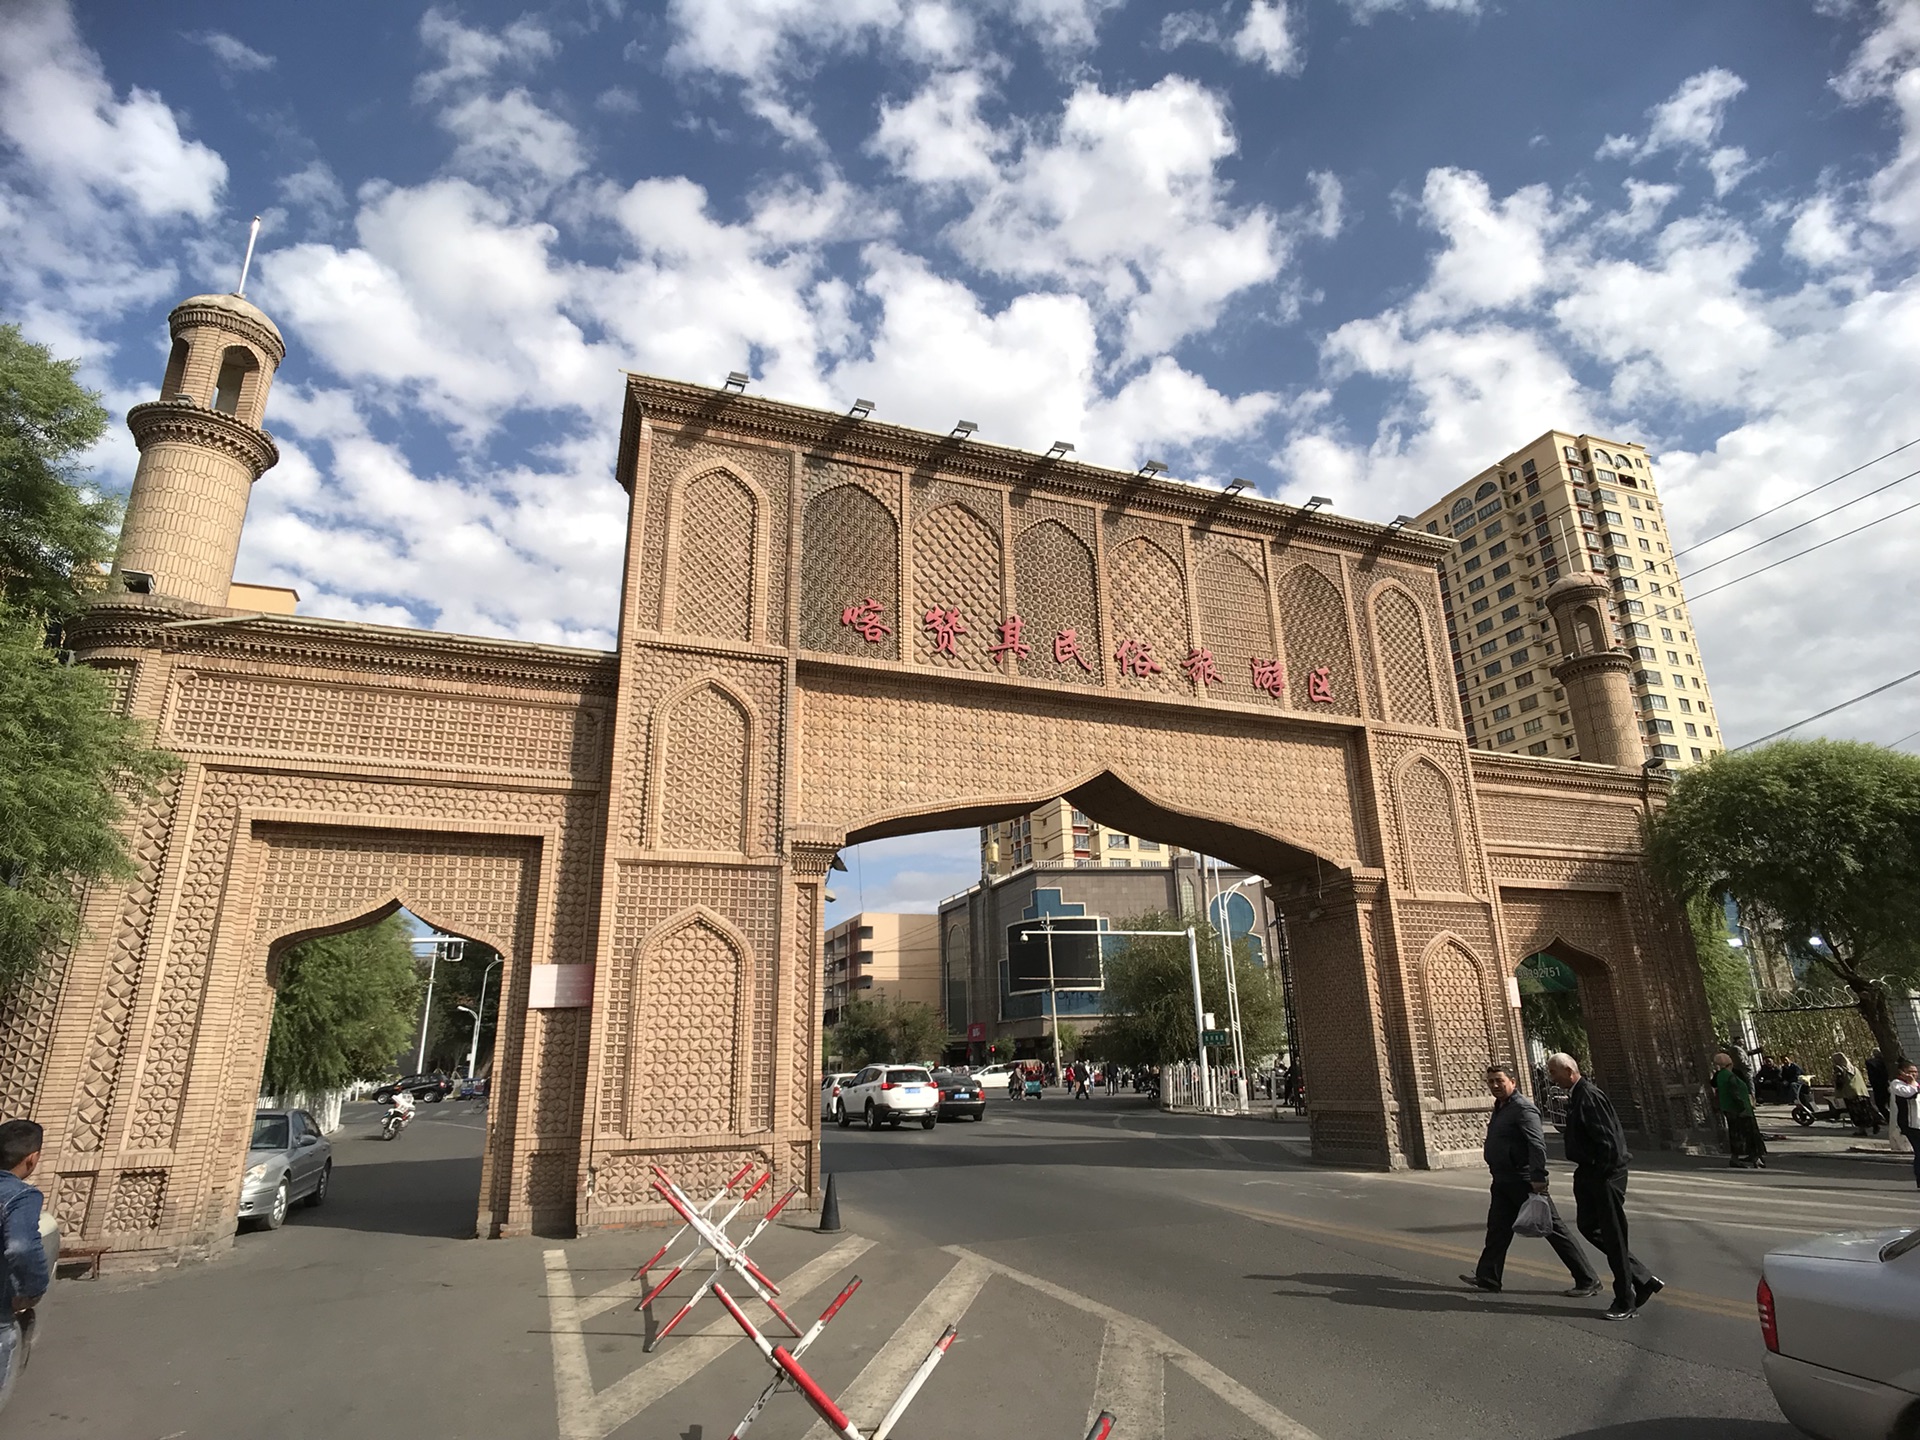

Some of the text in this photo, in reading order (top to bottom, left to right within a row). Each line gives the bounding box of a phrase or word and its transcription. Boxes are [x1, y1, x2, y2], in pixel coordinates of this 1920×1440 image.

[842, 598, 1334, 704] 喀赞其民俗旅游区
